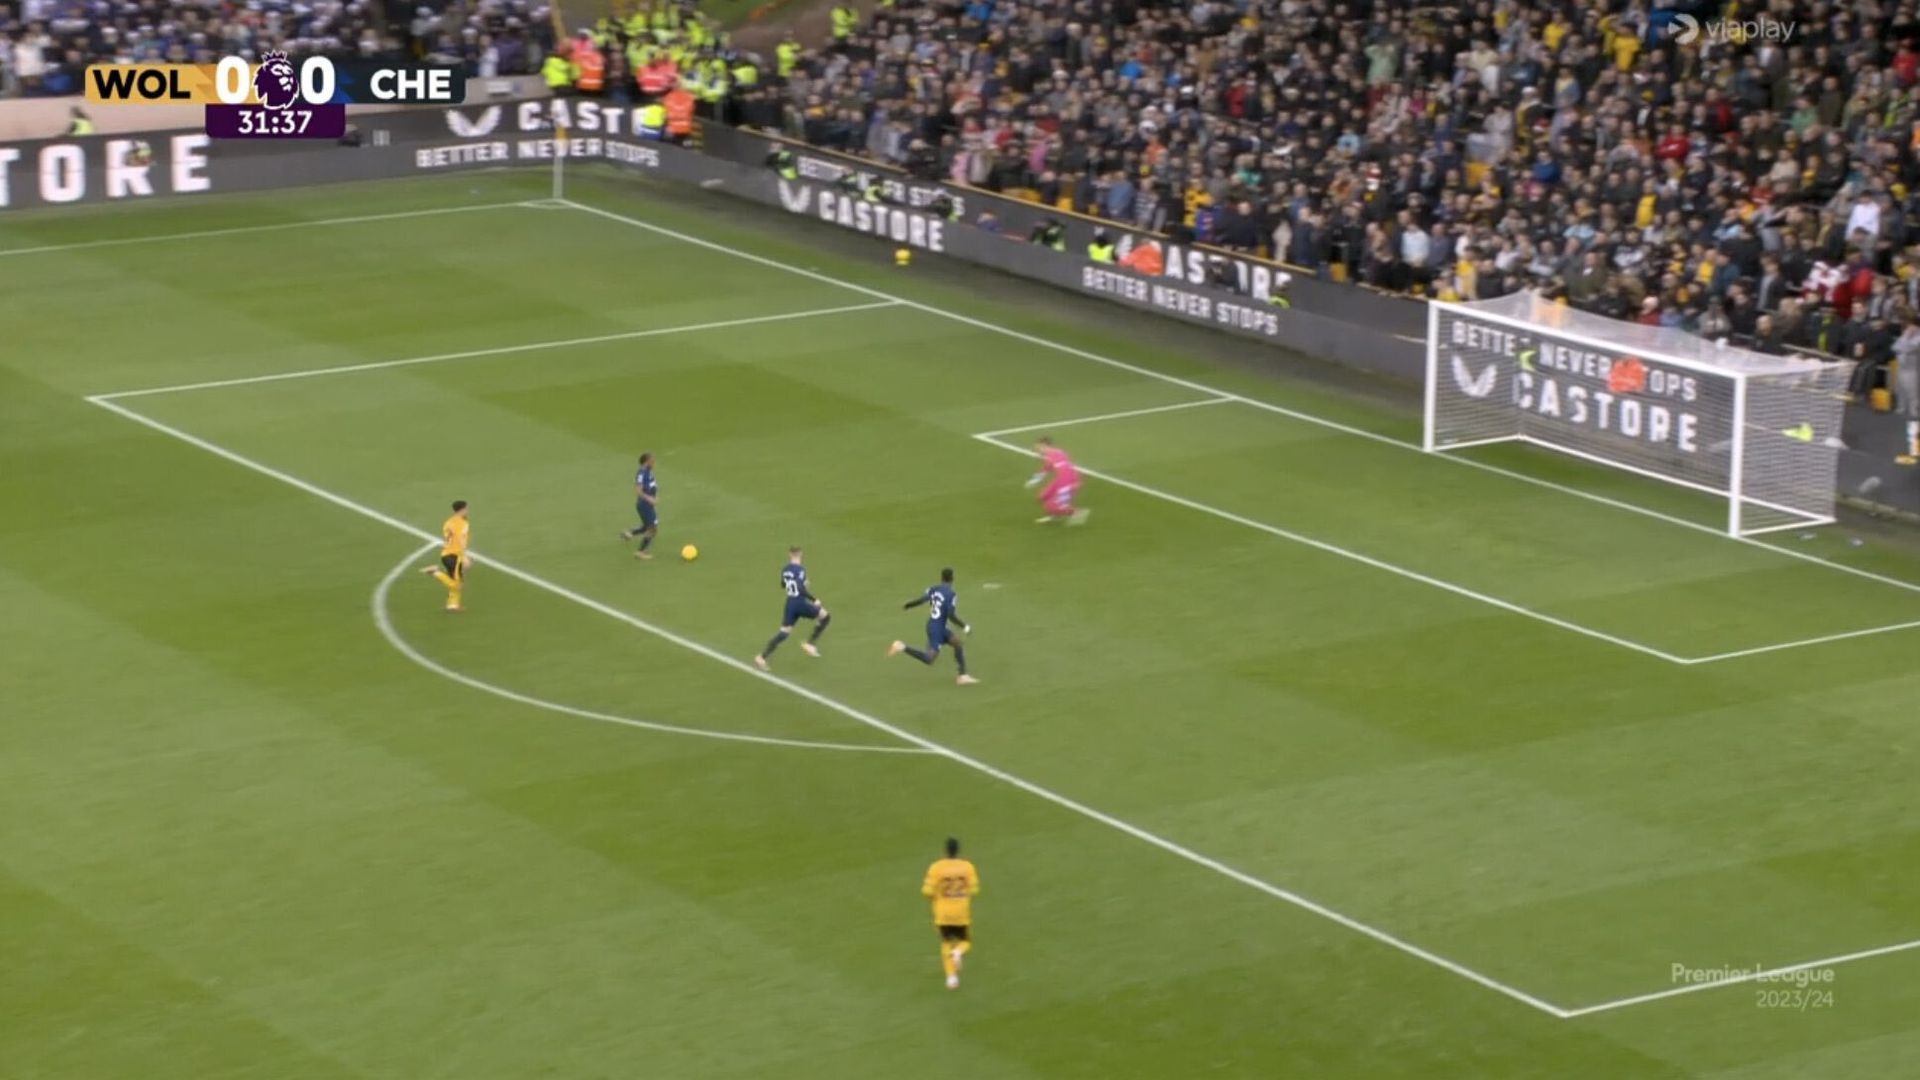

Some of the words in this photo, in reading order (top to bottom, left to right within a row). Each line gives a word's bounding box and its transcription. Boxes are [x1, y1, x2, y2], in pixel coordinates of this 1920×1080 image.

[416, 142, 508, 167] BETTER
[818, 190, 944, 252] CASTORE
[1082, 266, 1148, 301] BETTER
[1152, 285, 1211, 318] NEVER
[1216, 302, 1278, 335] STOPS
[1453, 320, 1530, 356] BETTE
[1643, 365, 1697, 401] OPS
[1513, 371, 1698, 452] CASTORE
